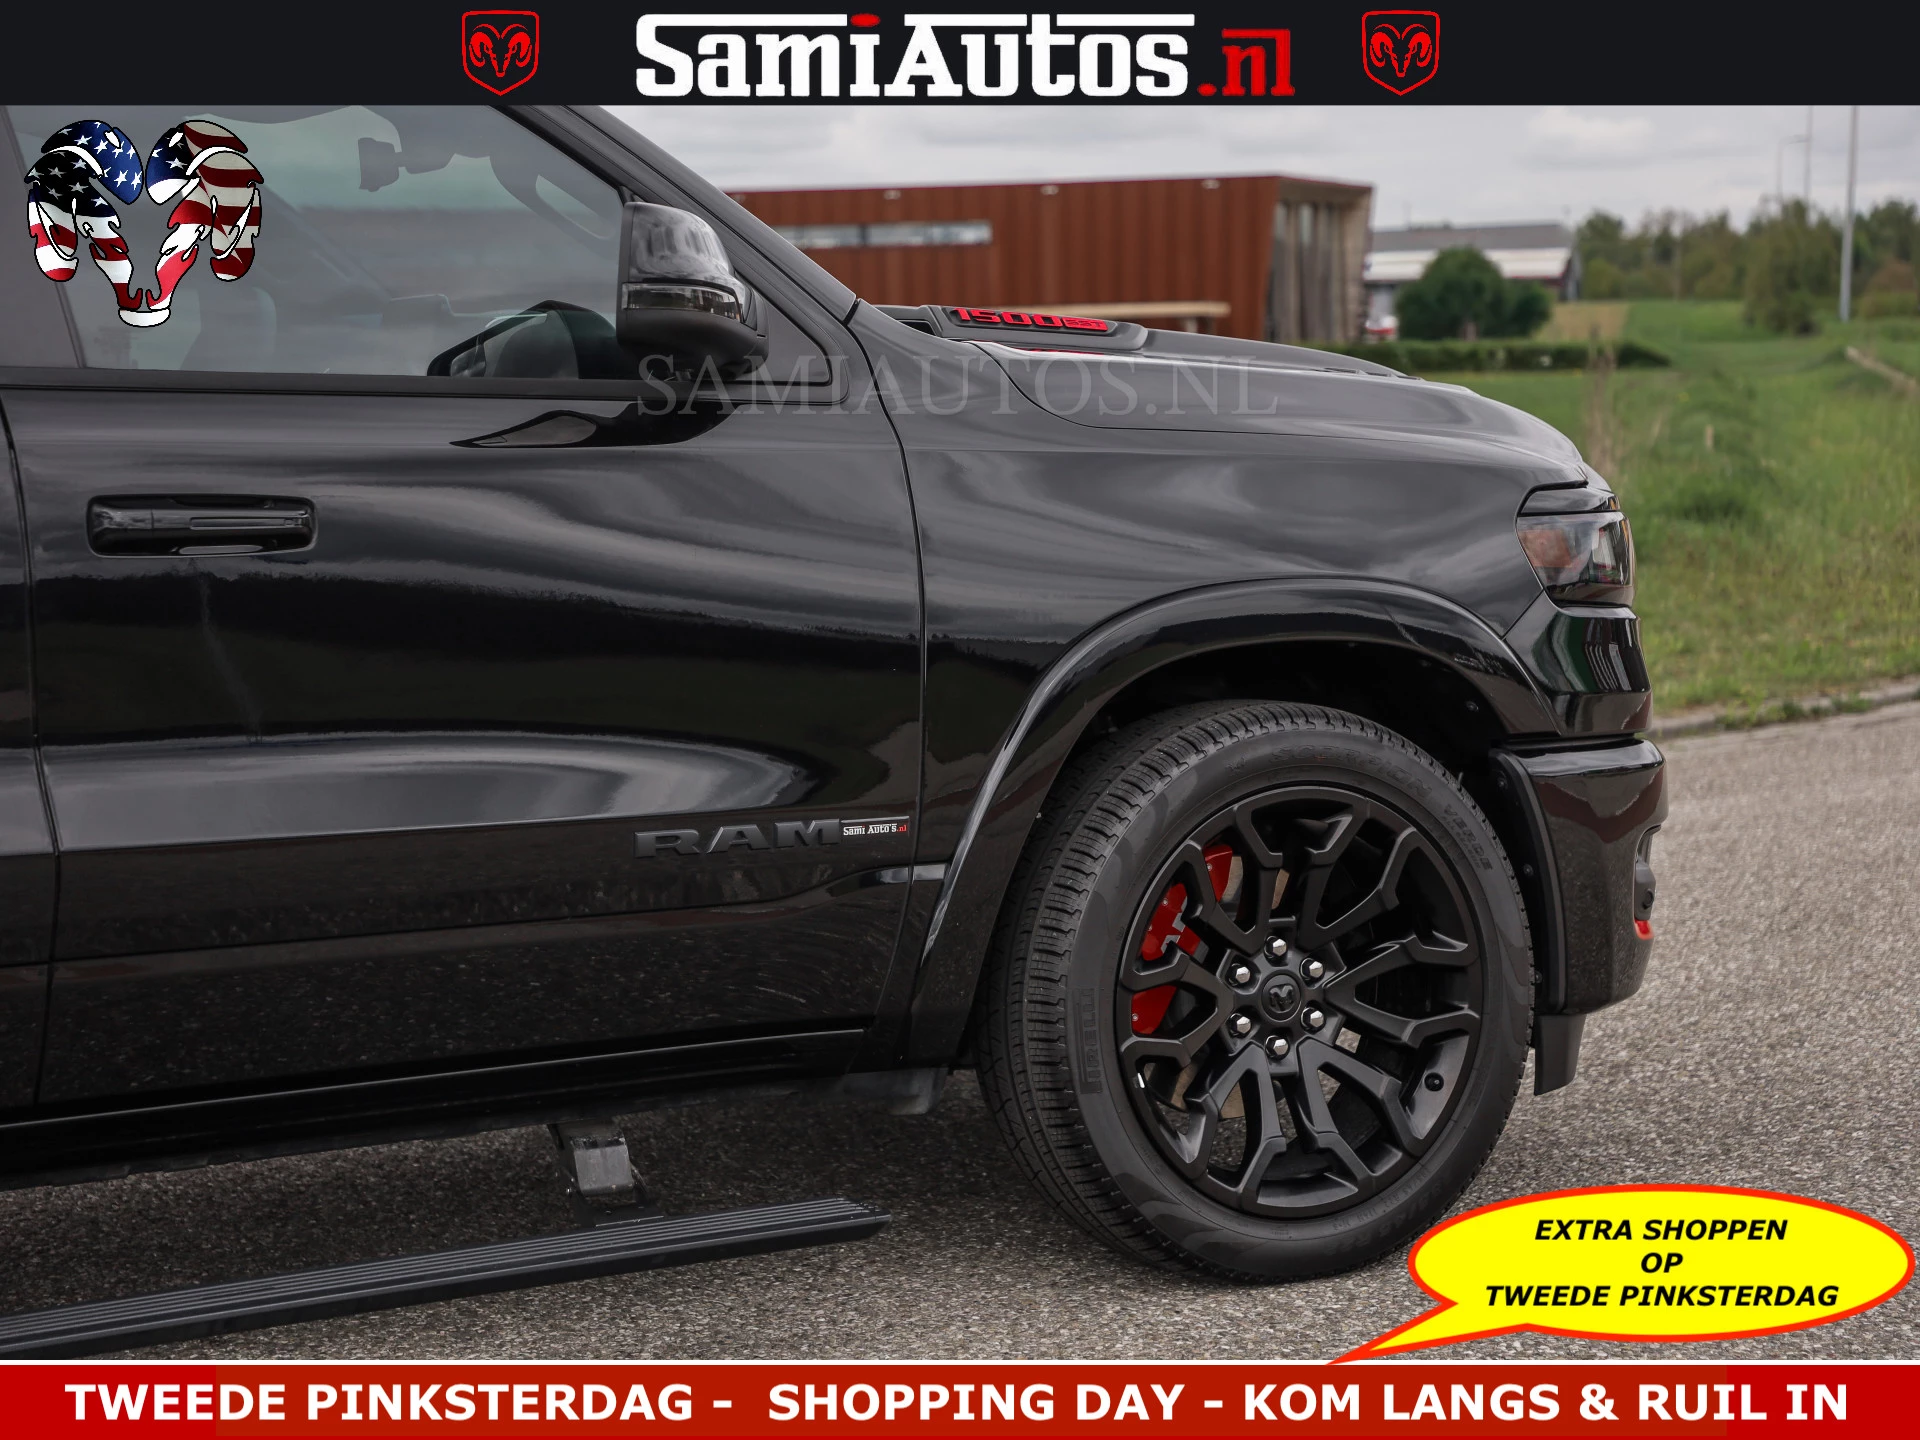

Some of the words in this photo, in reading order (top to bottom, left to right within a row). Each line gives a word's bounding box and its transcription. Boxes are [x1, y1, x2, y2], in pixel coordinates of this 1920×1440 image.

[952, 306, 1063, 328] 1500
[634, 818, 840, 858] RAM
[843, 824, 866, 836] Sami
